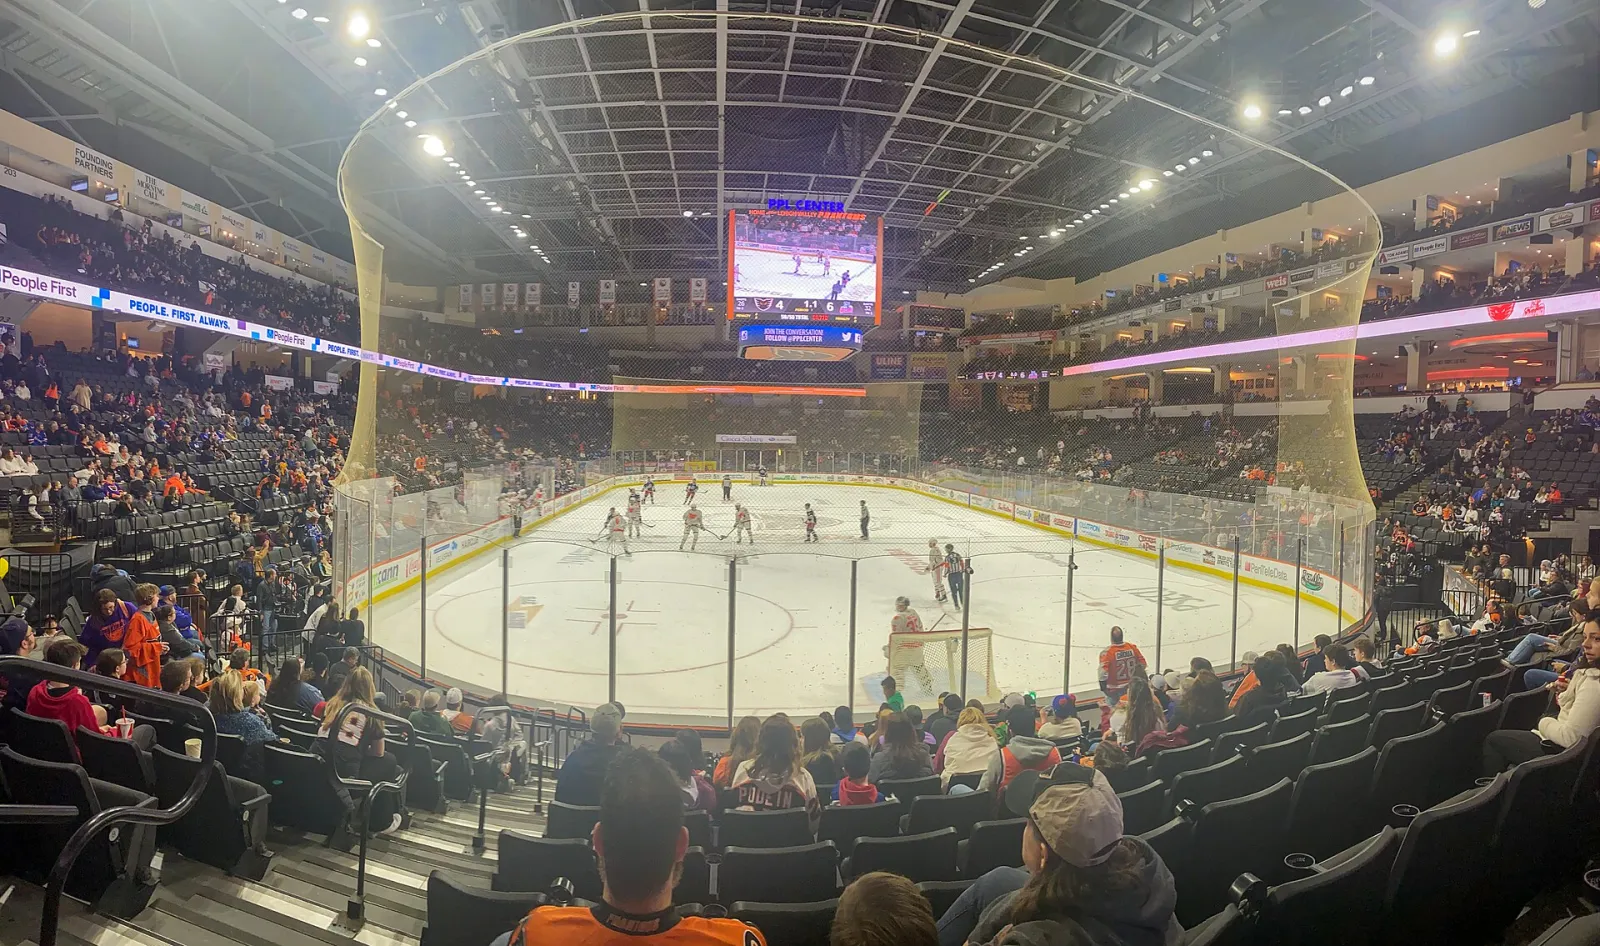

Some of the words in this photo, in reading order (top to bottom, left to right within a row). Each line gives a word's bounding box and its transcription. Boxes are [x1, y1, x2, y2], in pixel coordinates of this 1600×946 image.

[75, 147, 113, 170] FOUNDING
[4, 167, 17, 178] 203
[75, 157, 114, 180] PARTNERS
[145, 175, 157, 186] THE
[143, 188, 159, 201] CALL
[767, 198, 790, 210] PPL
[795, 199, 845, 213] CENTER
[1507, 222, 1530, 233] NEWS
[255, 231, 264, 241] ppl
[1419, 243, 1434, 252] People
[1434, 241, 1445, 249] First
[1, 269, 49, 295] People
[50, 281, 78, 300] First
[1266, 275, 1288, 289] weis
[775, 300, 784, 310] 4
[803, 300, 818, 308] 1.1
[826, 302, 835, 312] 6
[129, 299, 168, 318] PEOPLE.
[171, 308, 197, 326] FIRST.
[198, 313, 232, 332] ALWAYS.
[785, 329, 824, 337] CONVERSATION!
[273, 330, 293, 346] People
[293, 334, 306, 348] First
[787, 335, 823, 343] @PPLCENTER
[327, 343, 346, 357] PEOPLE.
[346, 346, 360, 360] FIRST.
[876, 357, 903, 367] ULINE
[1251, 563, 1288, 582] PenTeleData
